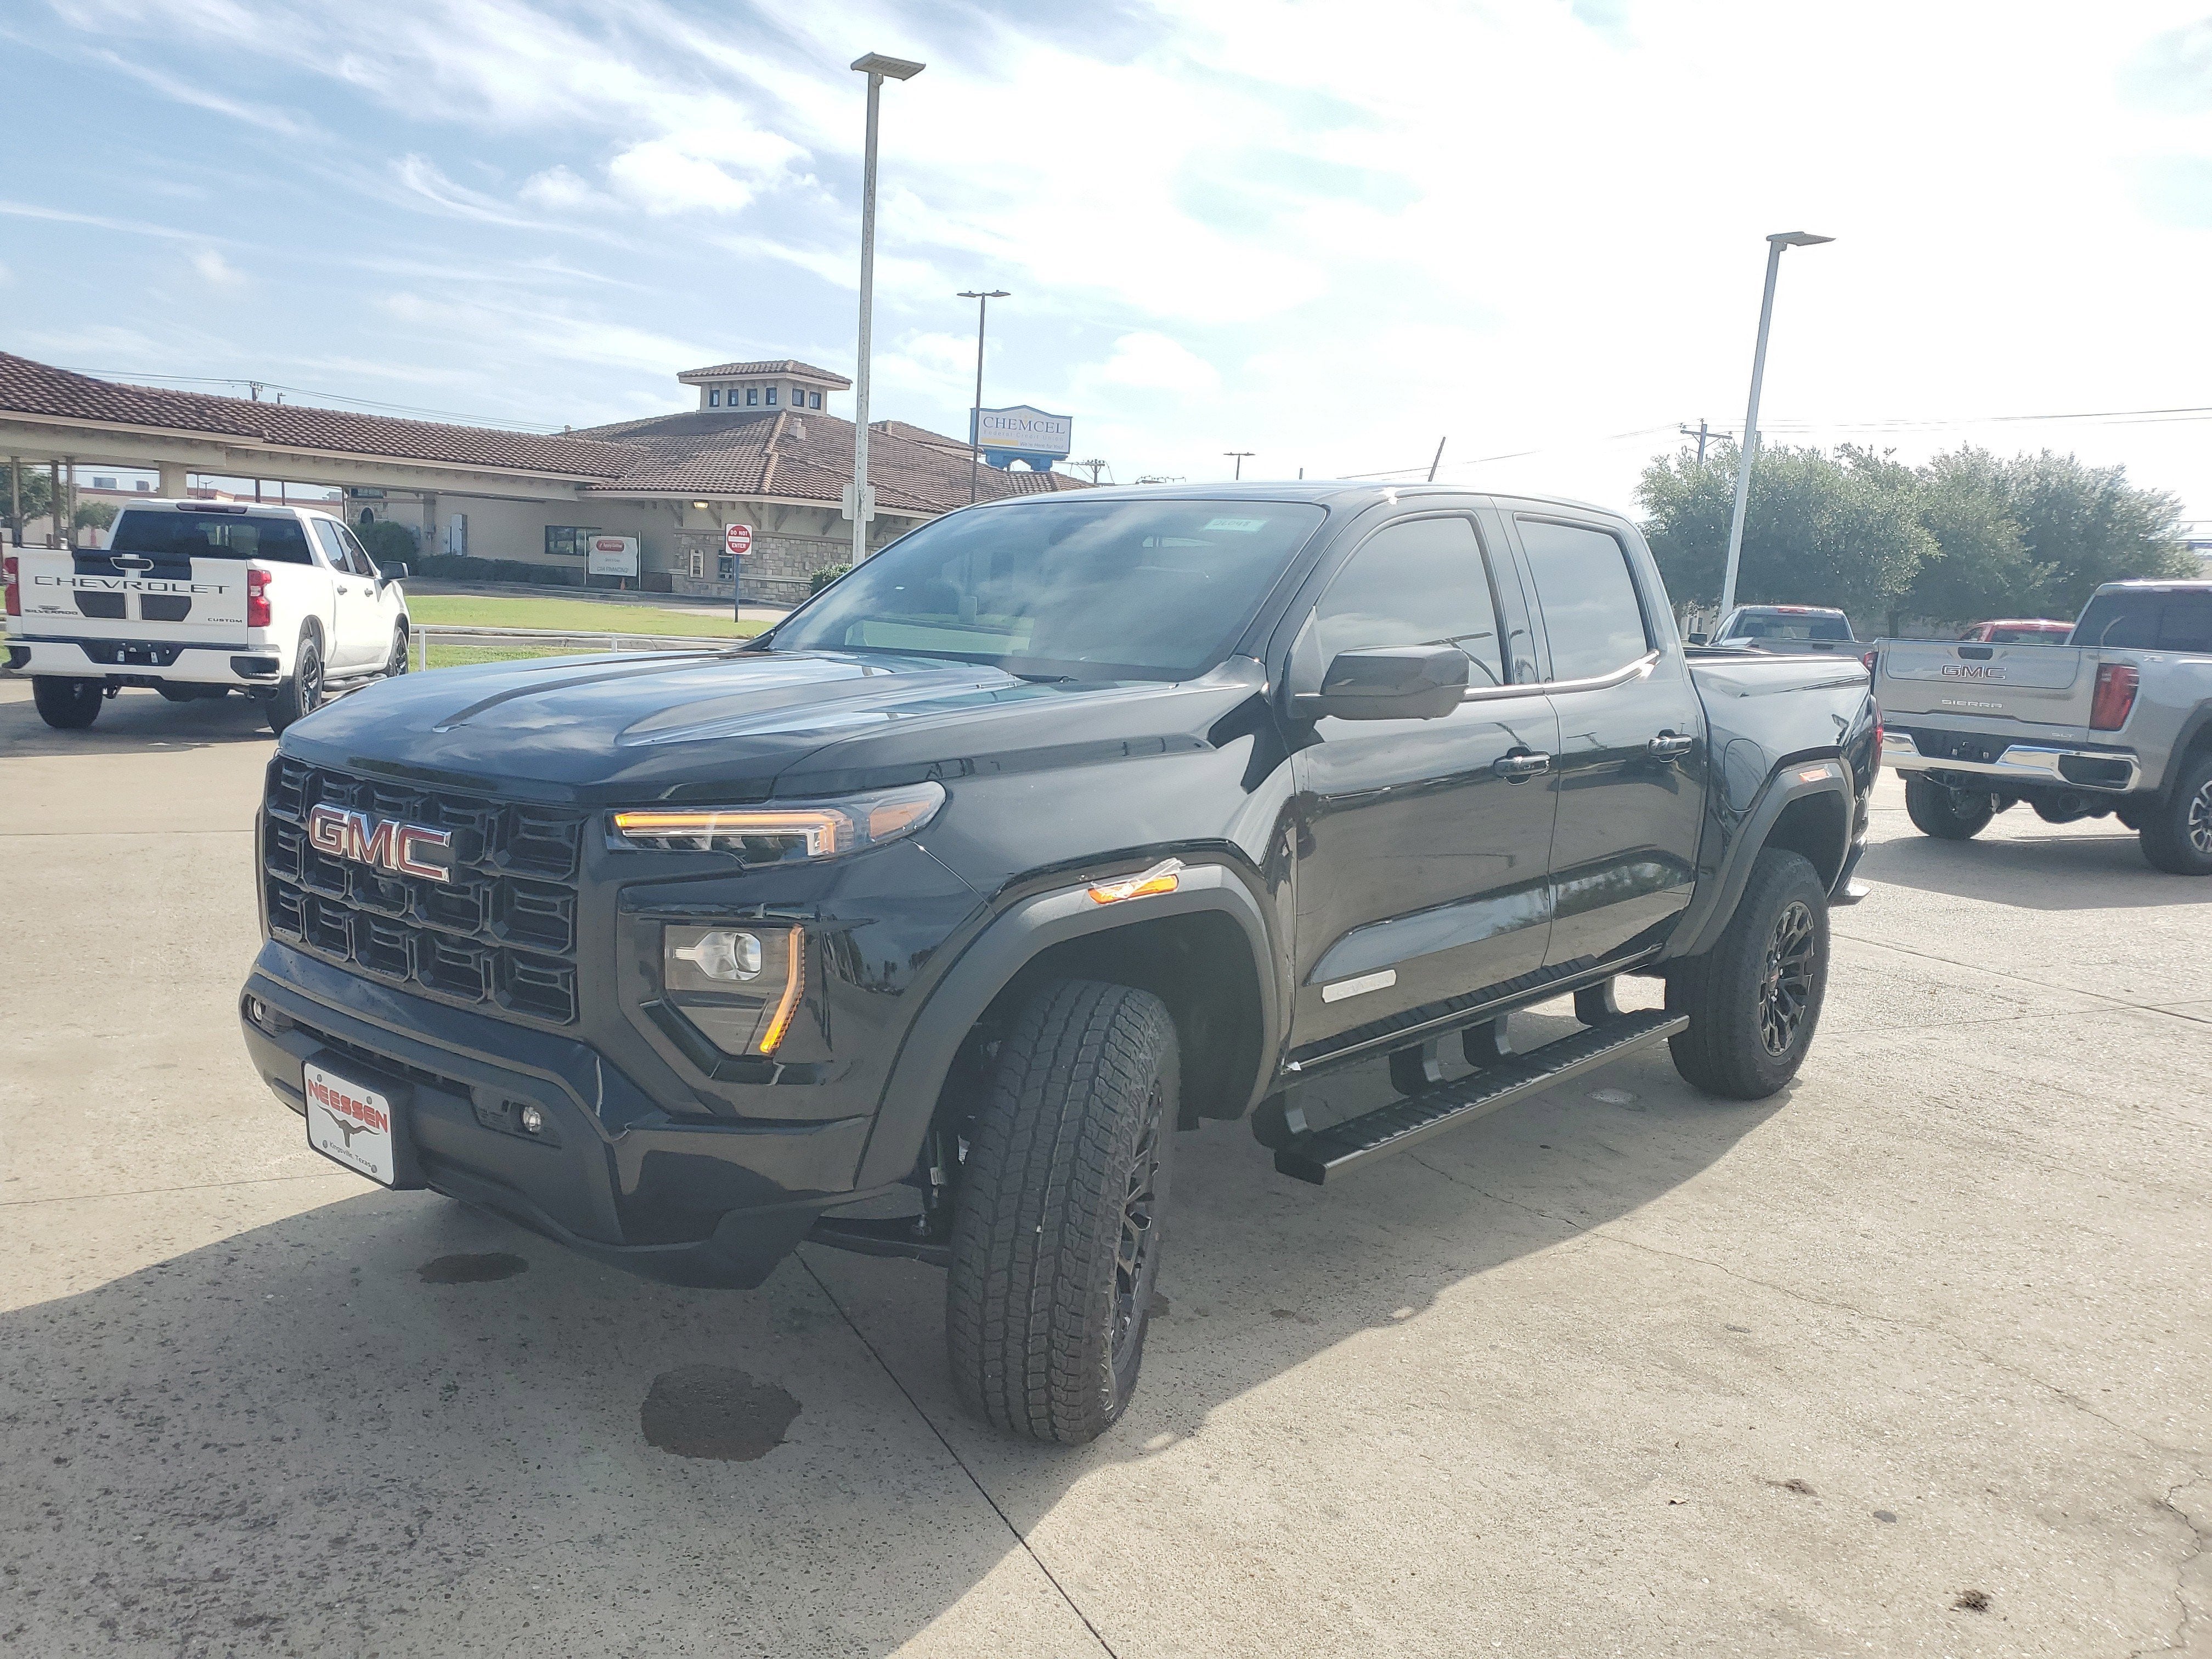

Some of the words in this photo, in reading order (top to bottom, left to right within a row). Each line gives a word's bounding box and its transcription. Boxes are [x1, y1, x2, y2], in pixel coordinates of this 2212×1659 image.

[983, 416, 1065, 434] CHEMCEL
[35, 575, 230, 594] CHEVROLET
[1941, 664, 2007, 680] GMC
[1942, 699, 2003, 708] SIERRA
[309, 803, 452, 883] GMC
[308, 1079, 388, 1133] NEESSEN
[354, 1154, 371, 1167] Texas
